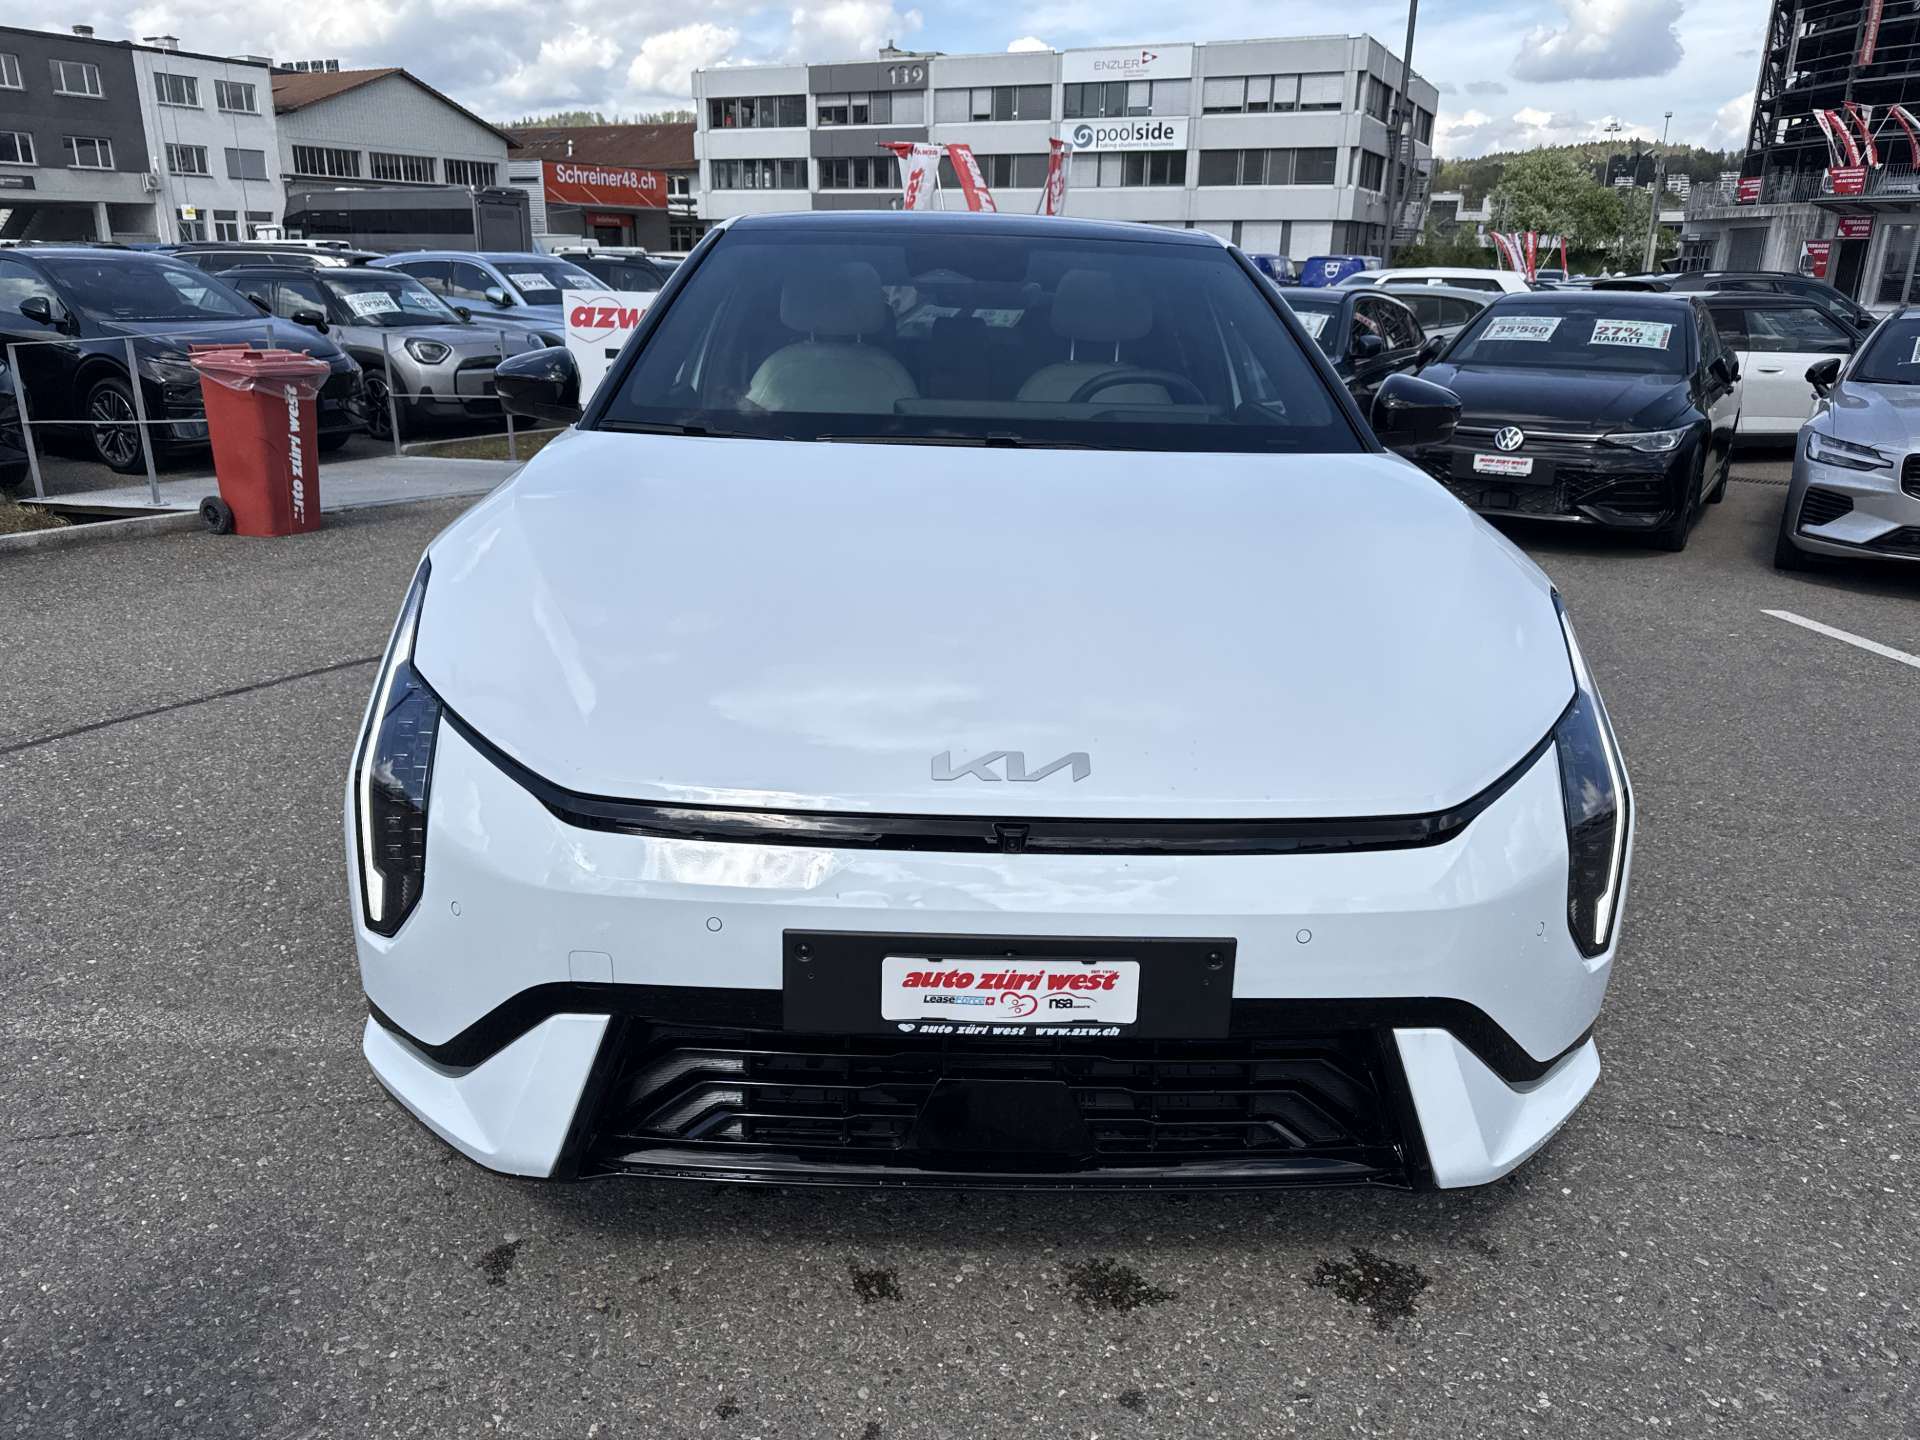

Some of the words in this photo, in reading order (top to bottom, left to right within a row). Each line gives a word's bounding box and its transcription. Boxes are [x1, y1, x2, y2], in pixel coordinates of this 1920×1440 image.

[1094, 59, 1140, 70] ENZLER
[888, 65, 924, 85] 139
[1096, 122, 1174, 148] poolside
[556, 164, 657, 190] Schreiner48.ch
[570, 305, 647, 329] azw
[1593, 334, 1643, 344] RABATT
[1596, 325, 1644, 338] 27%
[931, 750, 1092, 783] KIA
[902, 968, 975, 989] auto
[976, 969, 1046, 991] züri
[1046, 971, 1120, 991] west
[1049, 998, 1073, 1009] nsa
[919, 1024, 953, 1035] auto
[956, 1024, 989, 1036] züri
[992, 1026, 1026, 1036] west
[1035, 1026, 1121, 1037] www.azw.ch
